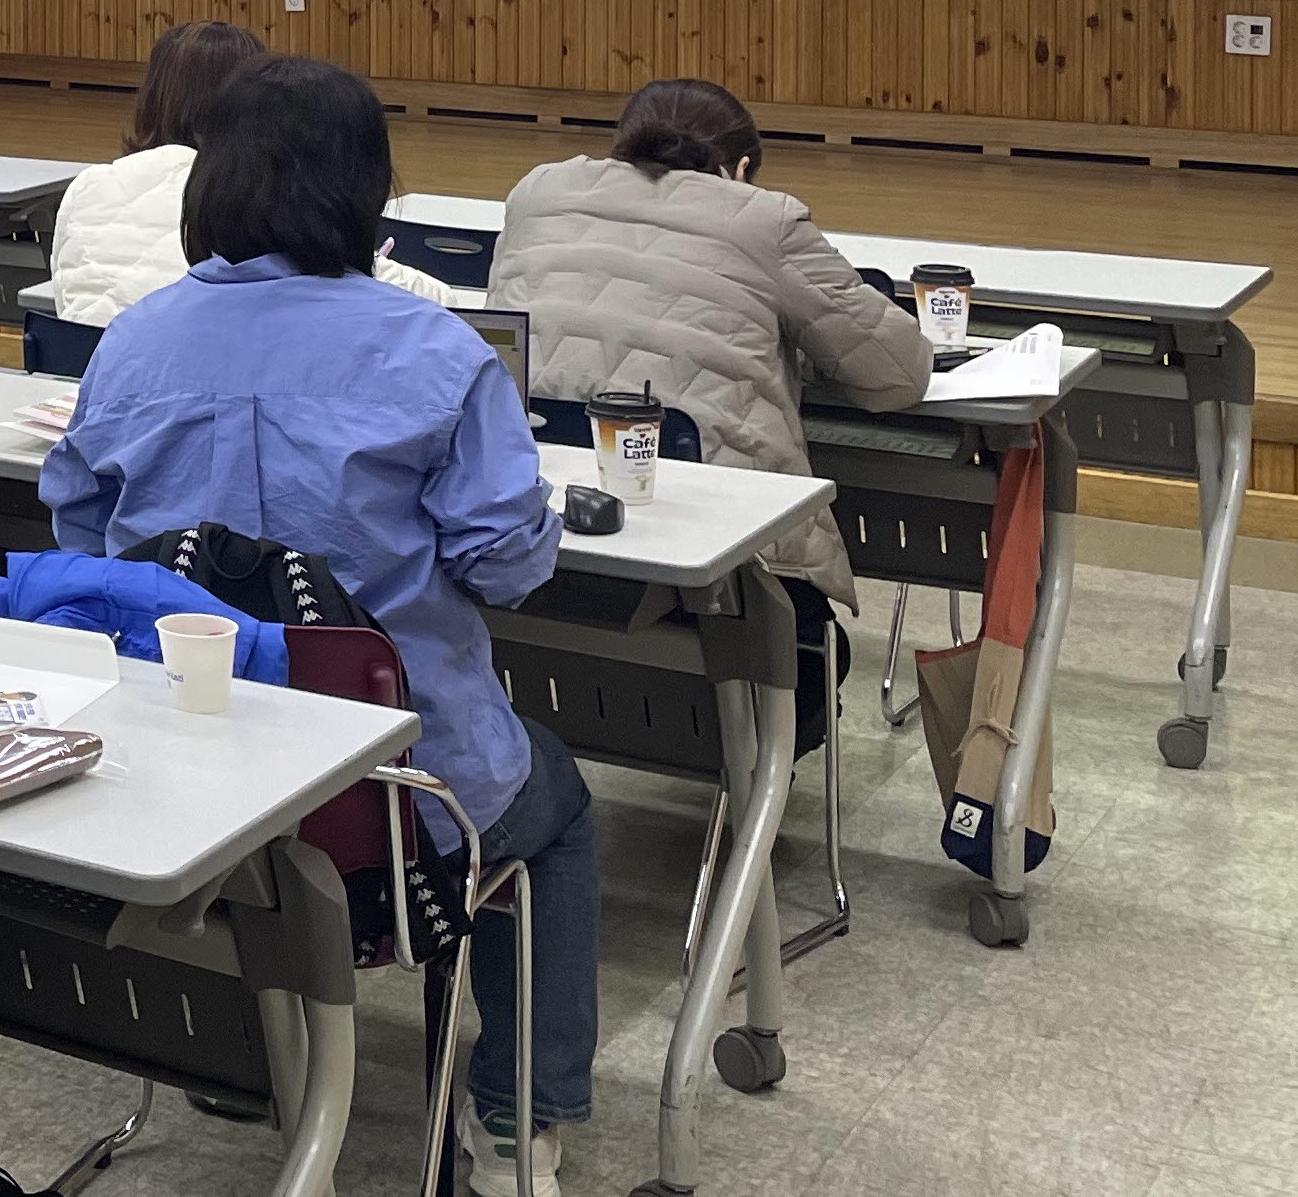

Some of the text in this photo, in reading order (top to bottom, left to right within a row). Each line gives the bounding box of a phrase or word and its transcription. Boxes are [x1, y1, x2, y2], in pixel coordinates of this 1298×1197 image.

[930, 297, 962, 307] Café
[931, 307, 962, 316] Latte
[622, 436, 656, 449] Café
